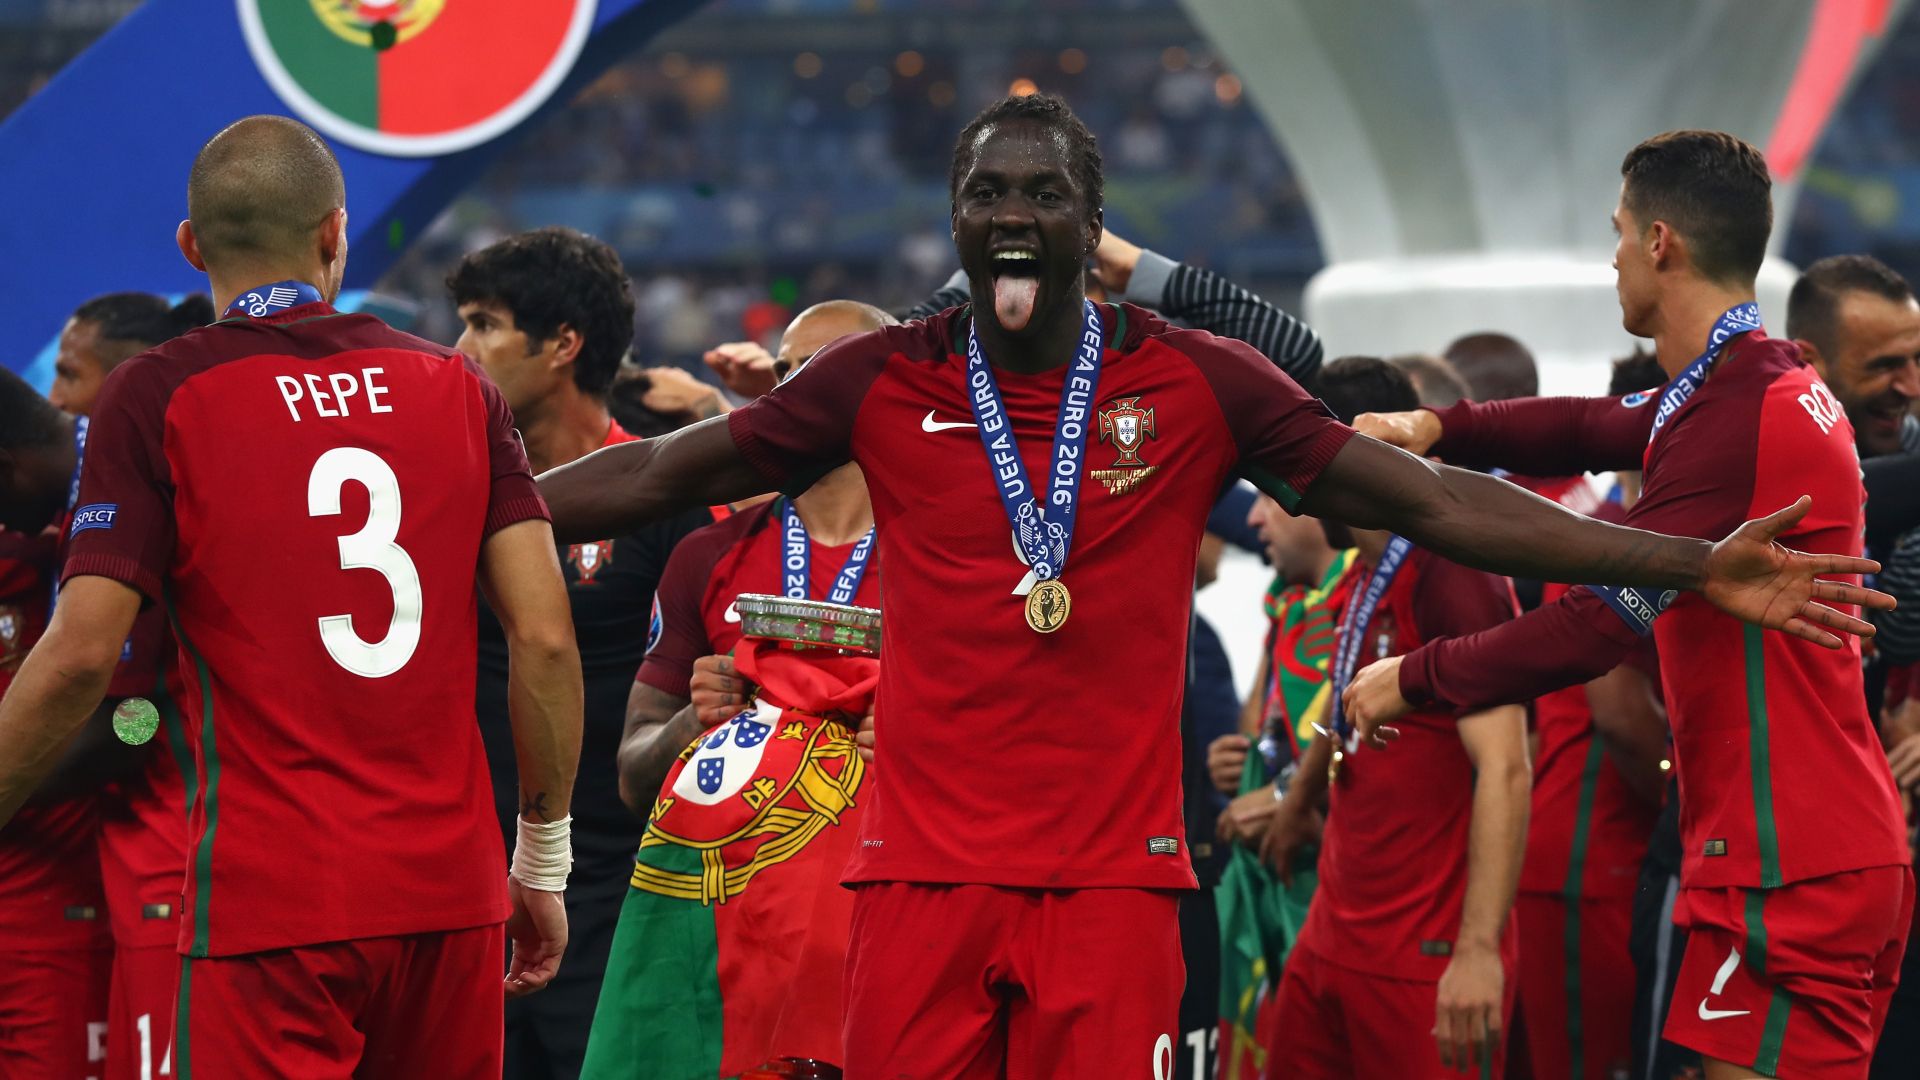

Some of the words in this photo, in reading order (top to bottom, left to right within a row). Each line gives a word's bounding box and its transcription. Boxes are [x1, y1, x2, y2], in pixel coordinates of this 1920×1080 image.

[1076, 314, 1101, 372] UEFA
[275, 367, 393, 422] PEPE
[971, 370, 1003, 433] EURO
[1061, 376, 1091, 439] EURO
[1655, 377, 1696, 428] EURO
[991, 432, 1025, 499] UEFA
[1052, 444, 1078, 506] 2016
[308, 446, 423, 678] 3
[787, 515, 805, 571] EURO
[831, 565, 861, 603] EFA
[852, 523, 876, 562] EU
[1378, 537, 1409, 574] EFA
[787, 573, 806, 600] 20
[1356, 574, 1387, 628] EURO
[1619, 587, 1639, 608] NO
[1637, 604, 1651, 620] TO
